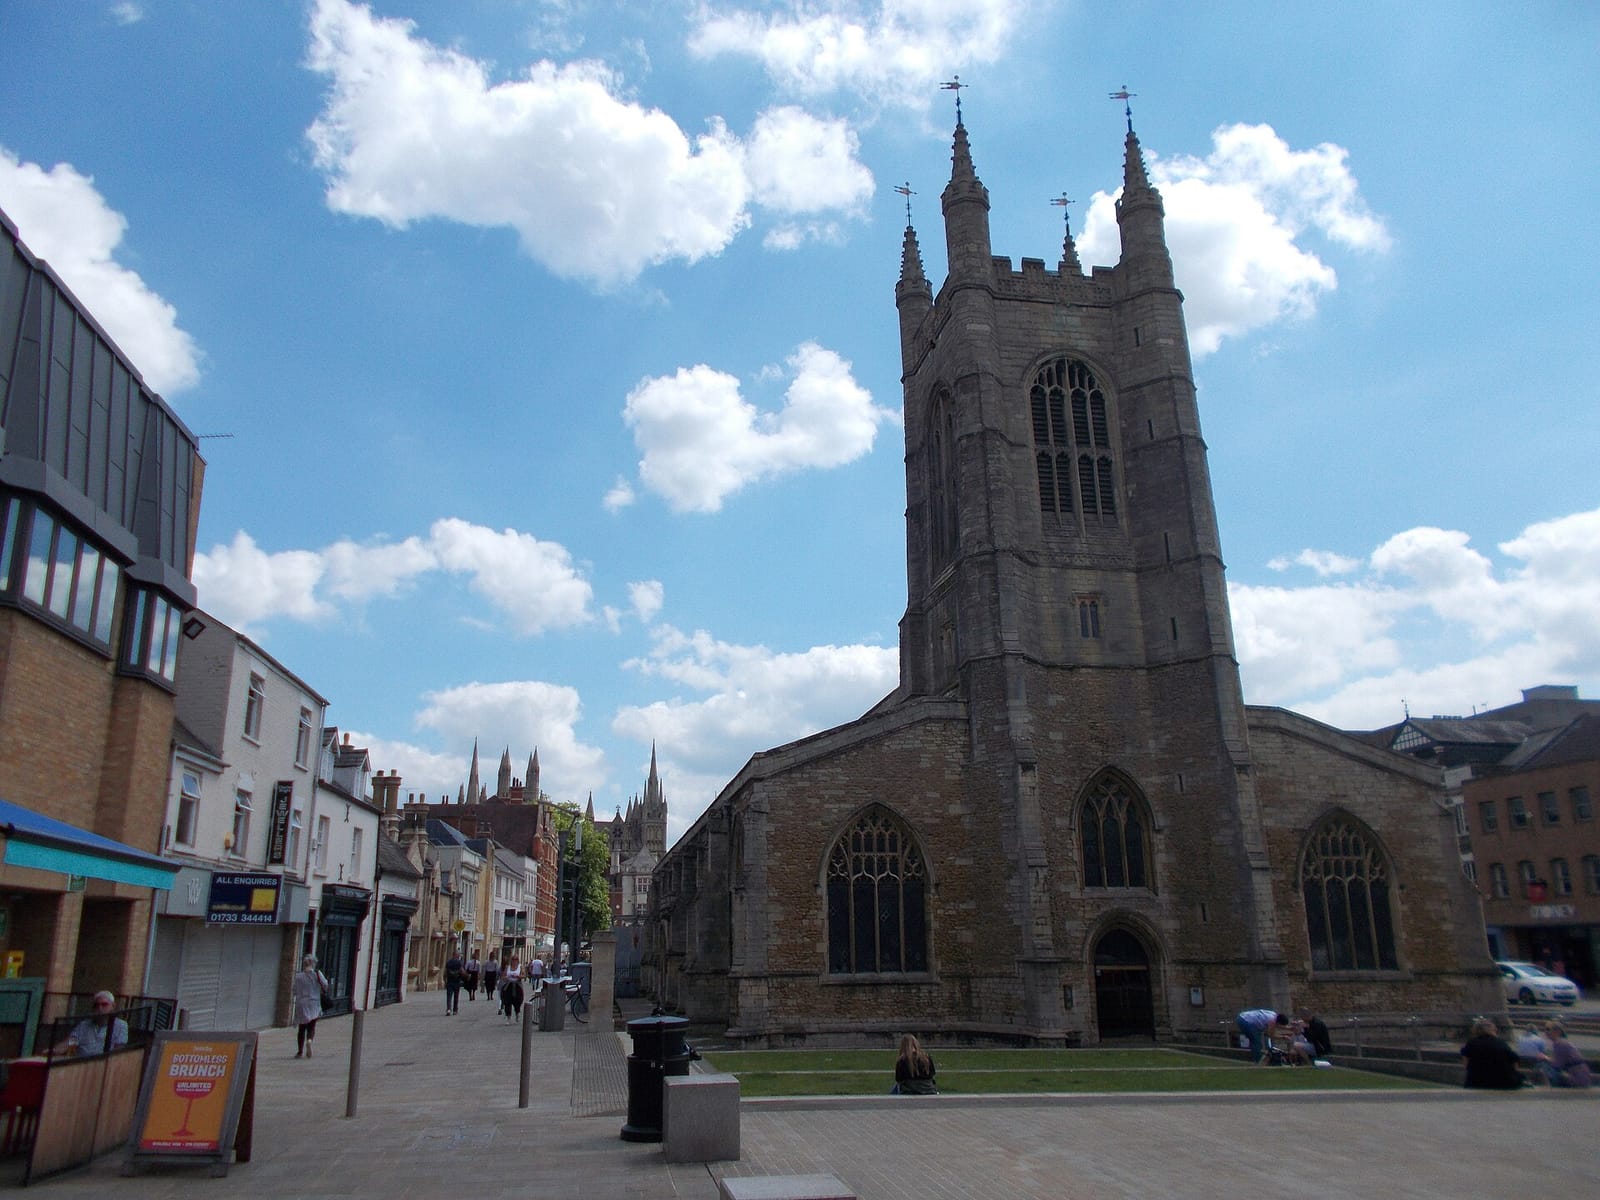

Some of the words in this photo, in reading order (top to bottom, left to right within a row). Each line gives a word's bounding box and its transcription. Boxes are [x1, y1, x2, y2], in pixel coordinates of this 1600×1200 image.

[216, 876, 232, 884] ALL
[234, 877, 277, 886] ENQUIRIES
[211, 913, 237, 922] 01733
[241, 914, 272, 922] 344414
[172, 1054, 228, 1064] BOTTOMLESS
[169, 1064, 227, 1077] BRUNCH
